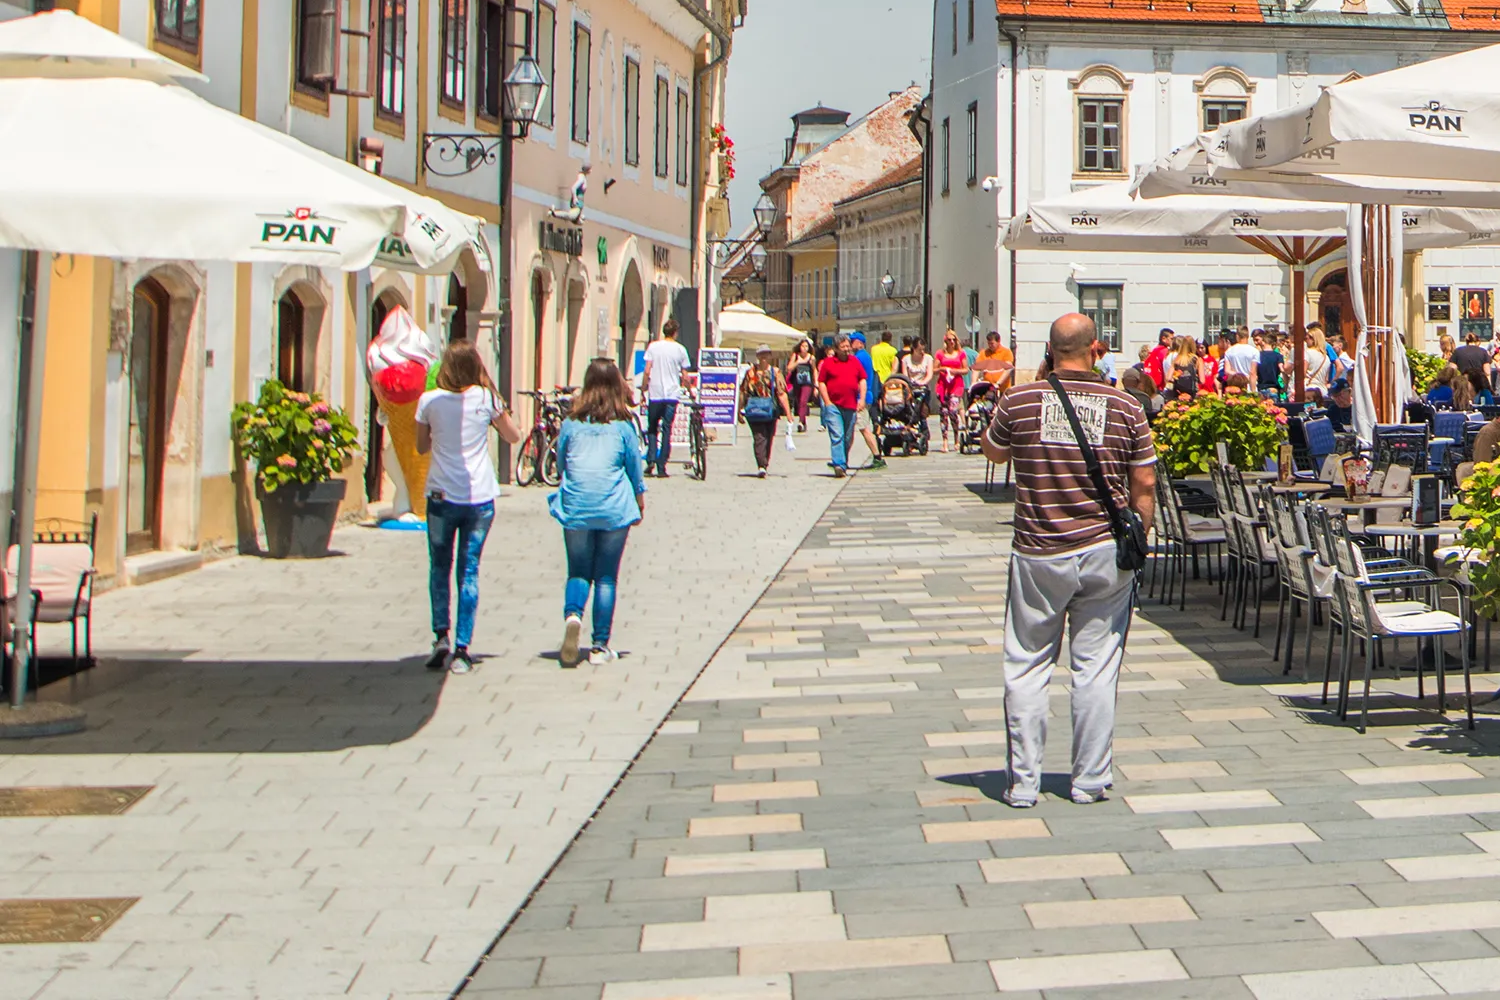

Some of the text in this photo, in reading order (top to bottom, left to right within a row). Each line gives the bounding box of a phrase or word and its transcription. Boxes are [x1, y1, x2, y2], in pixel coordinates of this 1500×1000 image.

[1409, 114, 1461, 132] PAN
[1071, 217, 1098, 226] PAN
[1233, 218, 1258, 226] PAN
[261, 222, 336, 245] PAN
